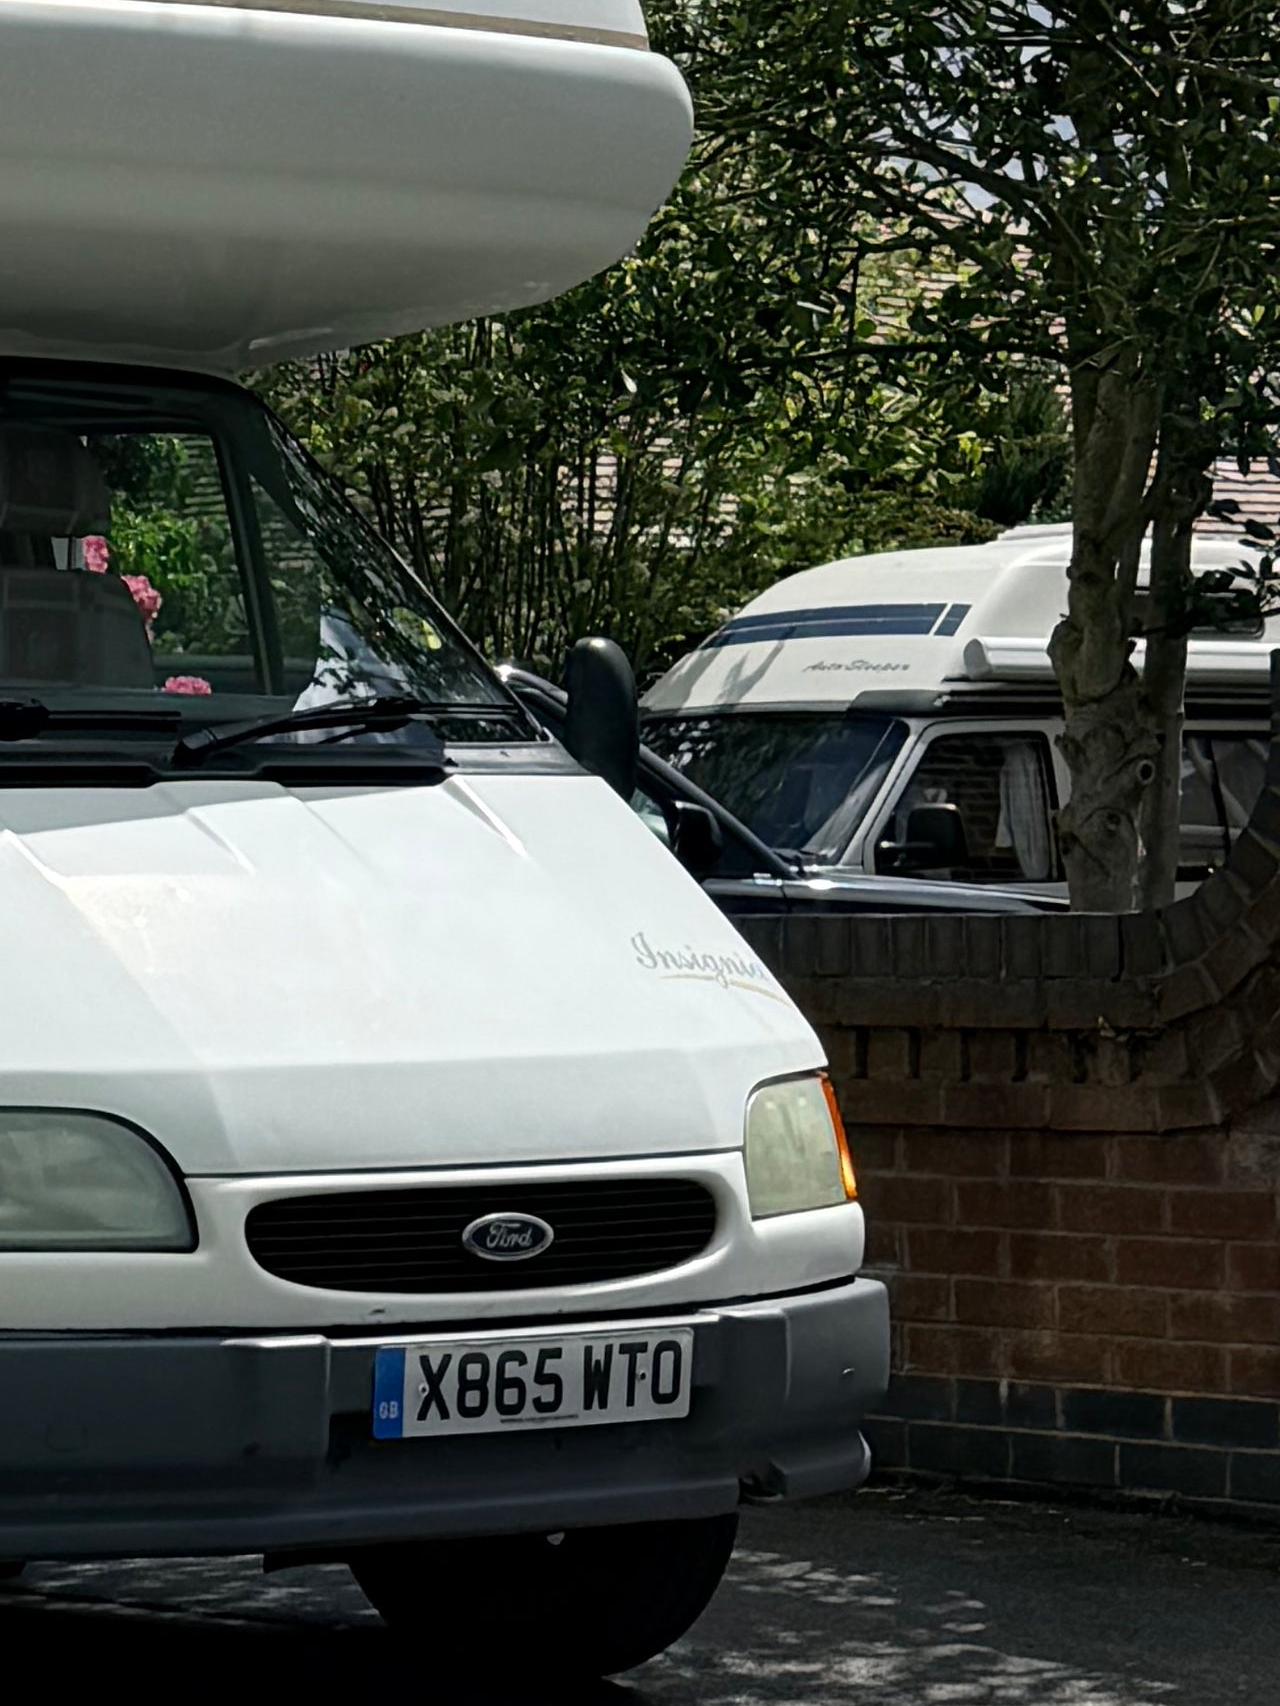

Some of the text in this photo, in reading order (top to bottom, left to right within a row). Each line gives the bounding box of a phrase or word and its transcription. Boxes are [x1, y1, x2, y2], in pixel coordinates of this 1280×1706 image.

[631, 932, 769, 989] Insignia
[485, 1222, 533, 1249] Ford
[416, 1341, 683, 1422] X865 WTO
[379, 1401, 400, 1420] GB
